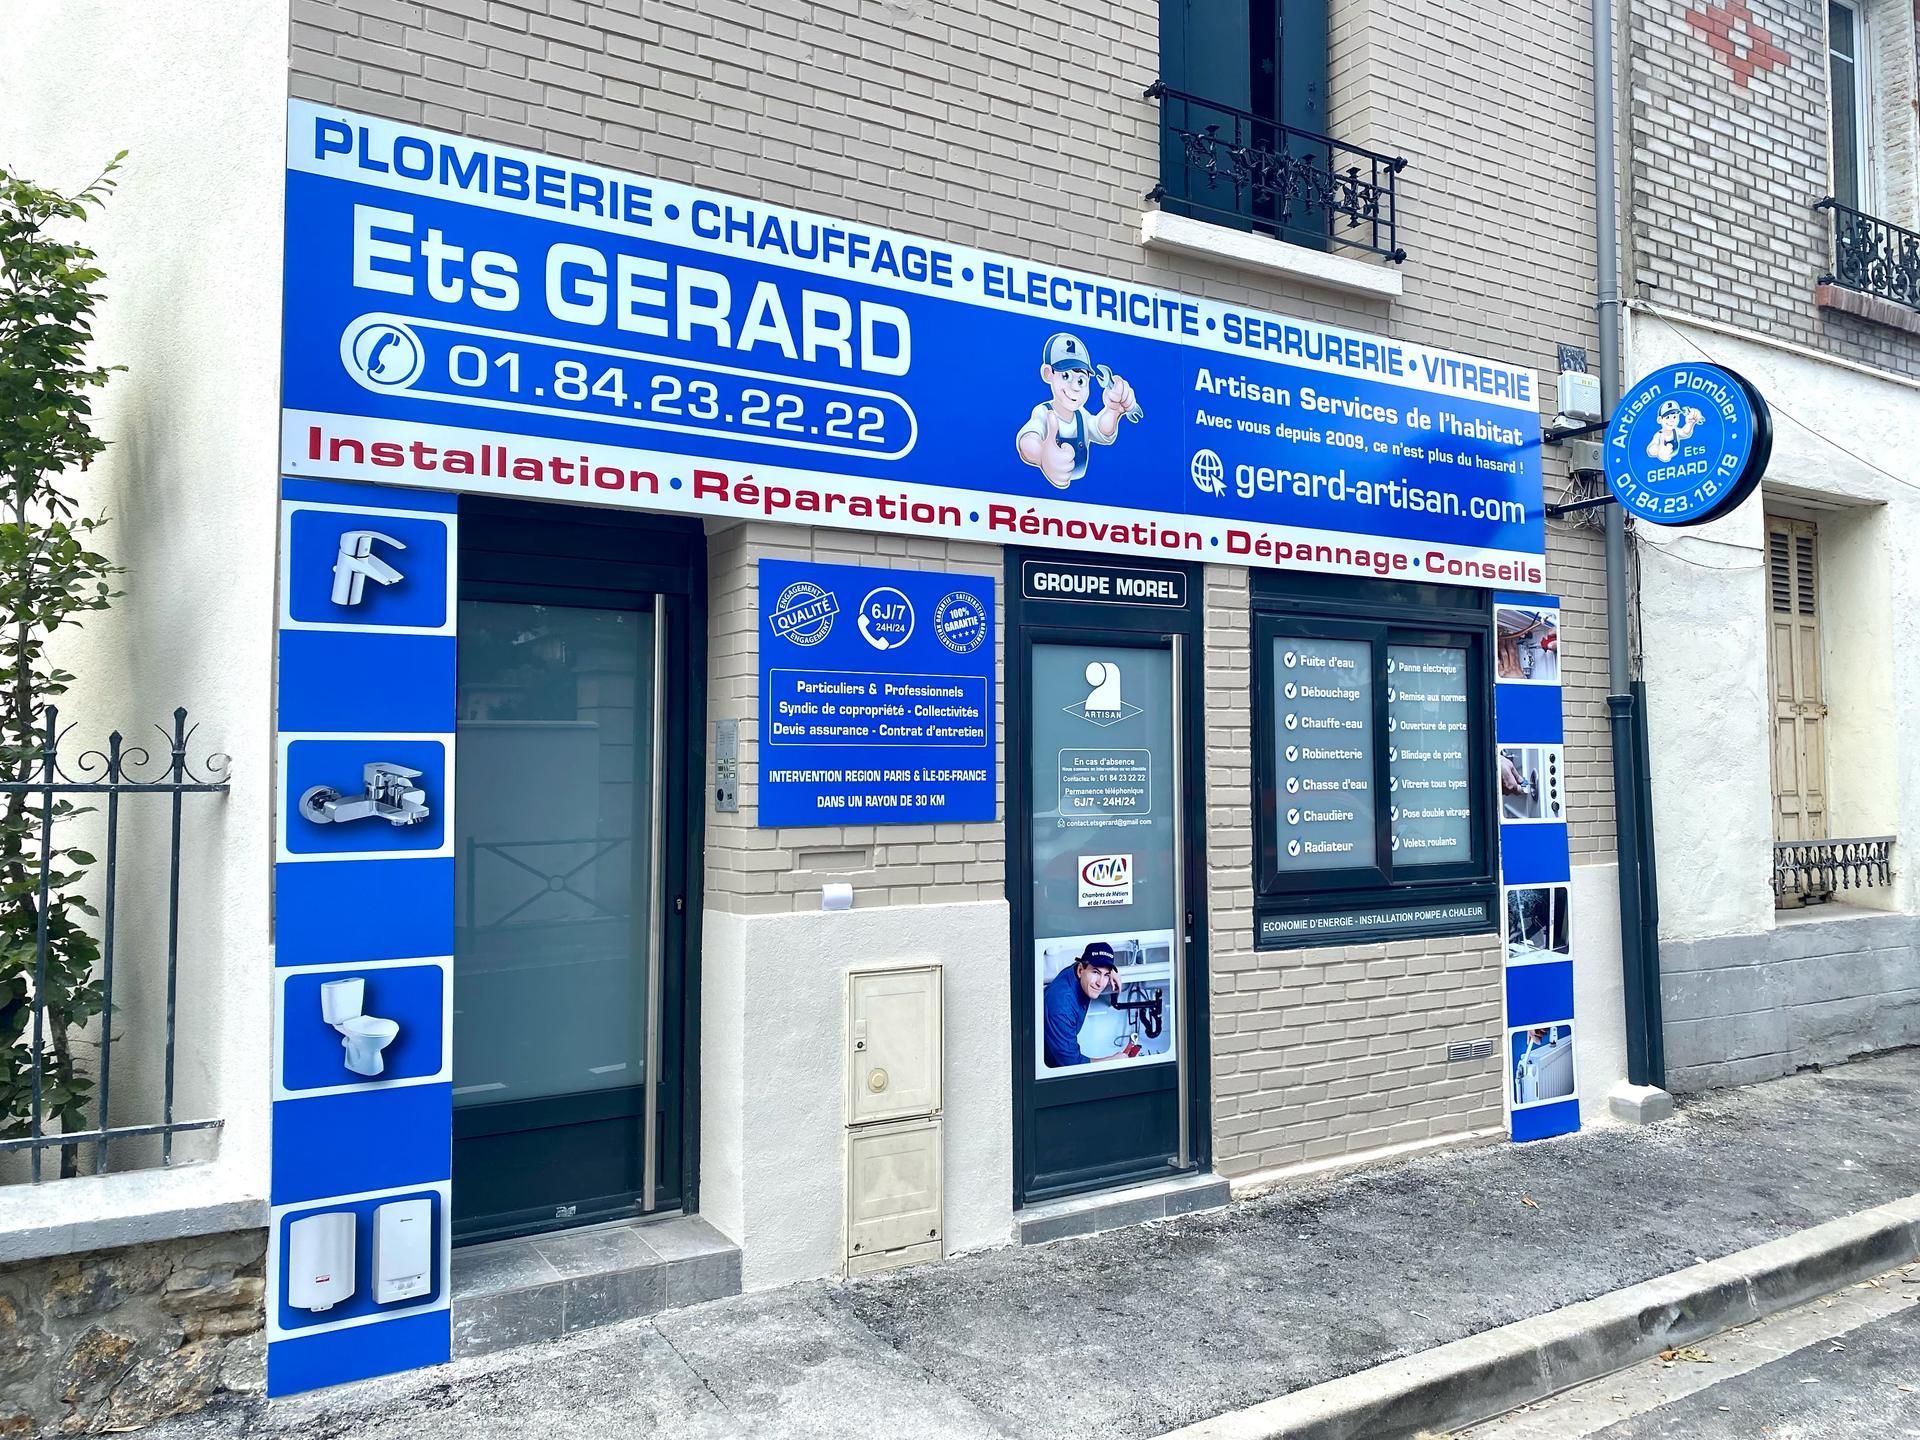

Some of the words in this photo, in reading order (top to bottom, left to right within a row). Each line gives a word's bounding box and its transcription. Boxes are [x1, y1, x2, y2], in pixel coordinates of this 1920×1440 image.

[315, 116, 653, 227] PLOMBERIE
[691, 199, 953, 288] CHAUFFAGE
[1224, 314, 1402, 377] SERRURERIE
[1422, 354, 1530, 402] VITRERIE
[353, 204, 519, 311] Ets
[545, 242, 911, 376] GERARD
[449, 345, 886, 443] 01.84.23.22.22
[1195, 369, 1290, 407] Artisan
[1300, 386, 1399, 425] Services
[1406, 406, 1431, 431] de
[1440, 412, 1523, 447] l'habitat
[1613, 384, 1661, 448] Artisan
[1674, 371, 1738, 424] Plombier
[1196, 409, 1236, 431] Avec
[1241, 419, 1272, 438] vous
[1275, 421, 1321, 445] depuis
[1325, 429, 1368, 454] 2009,
[1373, 440, 1388, 455] ce
[1392, 440, 1422, 459] n'est
[1427, 444, 1453, 467] plus
[1457, 449, 1471, 467] du
[1476, 451, 1515, 474] hasard
[1684, 445, 1706, 457] Ets
[1647, 460, 1708, 483] GERARD
[1616, 453, 1738, 513] 01.84.23.18.18
[1235, 463, 1525, 525] gerard-artisan.com
[308, 425, 659, 495] Installation
[693, 469, 961, 526] Réparation
[988, 503, 1201, 551] Rénovation
[1226, 529, 1408, 575] Dépannage
[1425, 551, 1541, 585] Conseils
[1034, 571, 1109, 597] GROUPE
[1116, 576, 1178, 600] MOREL
[780, 585, 821, 609] ENGAGEMENT
[778, 598, 831, 629] QUALITÉ
[871, 603, 906, 621] 6J/7
[949, 606, 970, 619] 100%
[790, 620, 830, 643] ENGAGEMENT
[876, 623, 905, 633] 24H/24
[944, 616, 979, 632] GARANTIE
[1300, 655, 1326, 667] Fuite
[1329, 656, 1354, 668] d'eau
[1399, 663, 1420, 673] Panne
[1422, 663, 1457, 675] électrique
[797, 680, 864, 695] Particuliers
[869, 683, 877, 695] &
[885, 683, 964, 698] Professionnels
[1301, 685, 1360, 701] Débouchage
[1399, 692, 1425, 702] Remise
[1427, 694, 1440, 702] aux
[1441, 693, 1467, 702] normes
[779, 701, 818, 717] Syndic
[822, 703, 835, 715] de
[839, 703, 904, 719] copropriété
[914, 704, 979, 718] Collectivités
[1085, 710, 1122, 719] ARTISAN
[773, 722, 805, 736] Devis
[809, 726, 869, 737] assurance
[879, 725, 923, 737] Contrat
[926, 725, 984, 738] d'entretien
[1400, 721, 1435, 731] Ouverture
[1437, 721, 1447, 731] de
[1448, 722, 1467, 732] porte
[1302, 747, 1363, 760] Robinetterie
[1401, 750, 1431, 761] Blindage
[1433, 750, 1443, 760] de
[1444, 750, 1462, 761] porte
[1074, 758, 1084, 766] En
[1099, 758, 1135, 766] d'absence
[769, 770, 842, 783] INTERVENTION
[845, 770, 881, 782] REGION
[884, 770, 911, 782] PARIS
[914, 771, 920, 782] &
[923, 767, 987, 782] ÎLE-DE-FRANCE
[1104, 787, 1144, 796] téléphonique
[1303, 779, 1338, 791] Chasse
[1341, 778, 1368, 790] d'eau
[1402, 778, 1429, 789] Vitrerie
[1430, 779, 1447, 789] tous
[1448, 779, 1467, 790] types
[817, 796, 845, 808] DANS
[848, 796, 862, 807] UN
[865, 796, 897, 807] RAYON
[900, 796, 913, 807] DE
[915, 795, 927, 807] 30
[930, 795, 945, 806] KM
[1074, 798, 1094, 807] 6J/7
[1102, 797, 1136, 807] 24H/24
[1303, 810, 1353, 822] Chaudière
[1402, 808, 1420, 818] Pose
[1422, 807, 1444, 818] double
[1445, 807, 1471, 819] vitrage
[1304, 841, 1353, 853] Radiateur
[1427, 836, 1457, 847] roulants
[1263, 919, 1308, 932] ECONOMIE
[1310, 916, 1353, 929] D'ENERGIE
[1359, 912, 1412, 926] INSTALLATION
[1415, 910, 1441, 922] POMPE
[1442, 909, 1448, 919] A
[1449, 907, 1483, 918] CHALEUR
